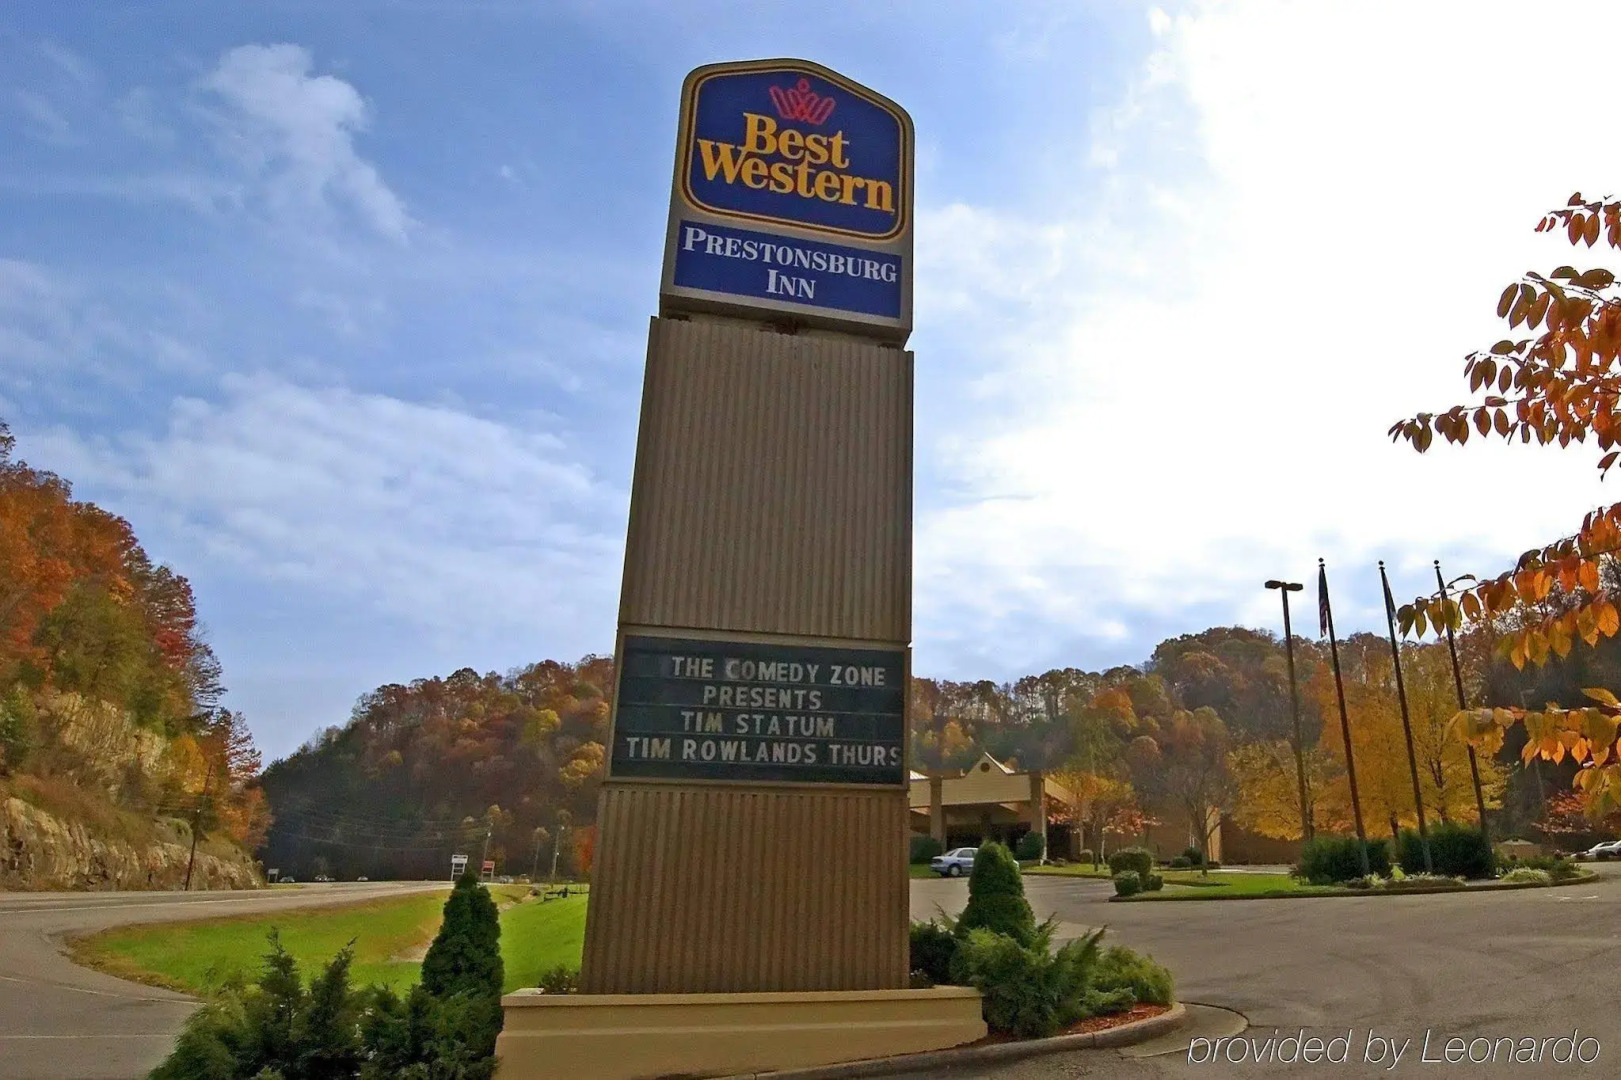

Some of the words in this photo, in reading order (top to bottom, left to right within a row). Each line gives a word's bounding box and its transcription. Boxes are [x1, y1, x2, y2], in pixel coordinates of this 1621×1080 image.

[743, 112, 849, 169] Best
[697, 138, 895, 213] Western
[682, 226, 898, 283] PRESTONSBURG
[765, 268, 816, 299] INN
[671, 655, 713, 679] THE
[725, 657, 819, 684] COMEDY
[830, 664, 886, 687] ZONE
[703, 685, 822, 710] PRESENTS
[681, 711, 723, 733] TIM
[736, 713, 834, 738] STATUM
[626, 736, 670, 759] TIM
[682, 739, 817, 765] ROWLANDS
[828, 744, 899, 767] THURS
